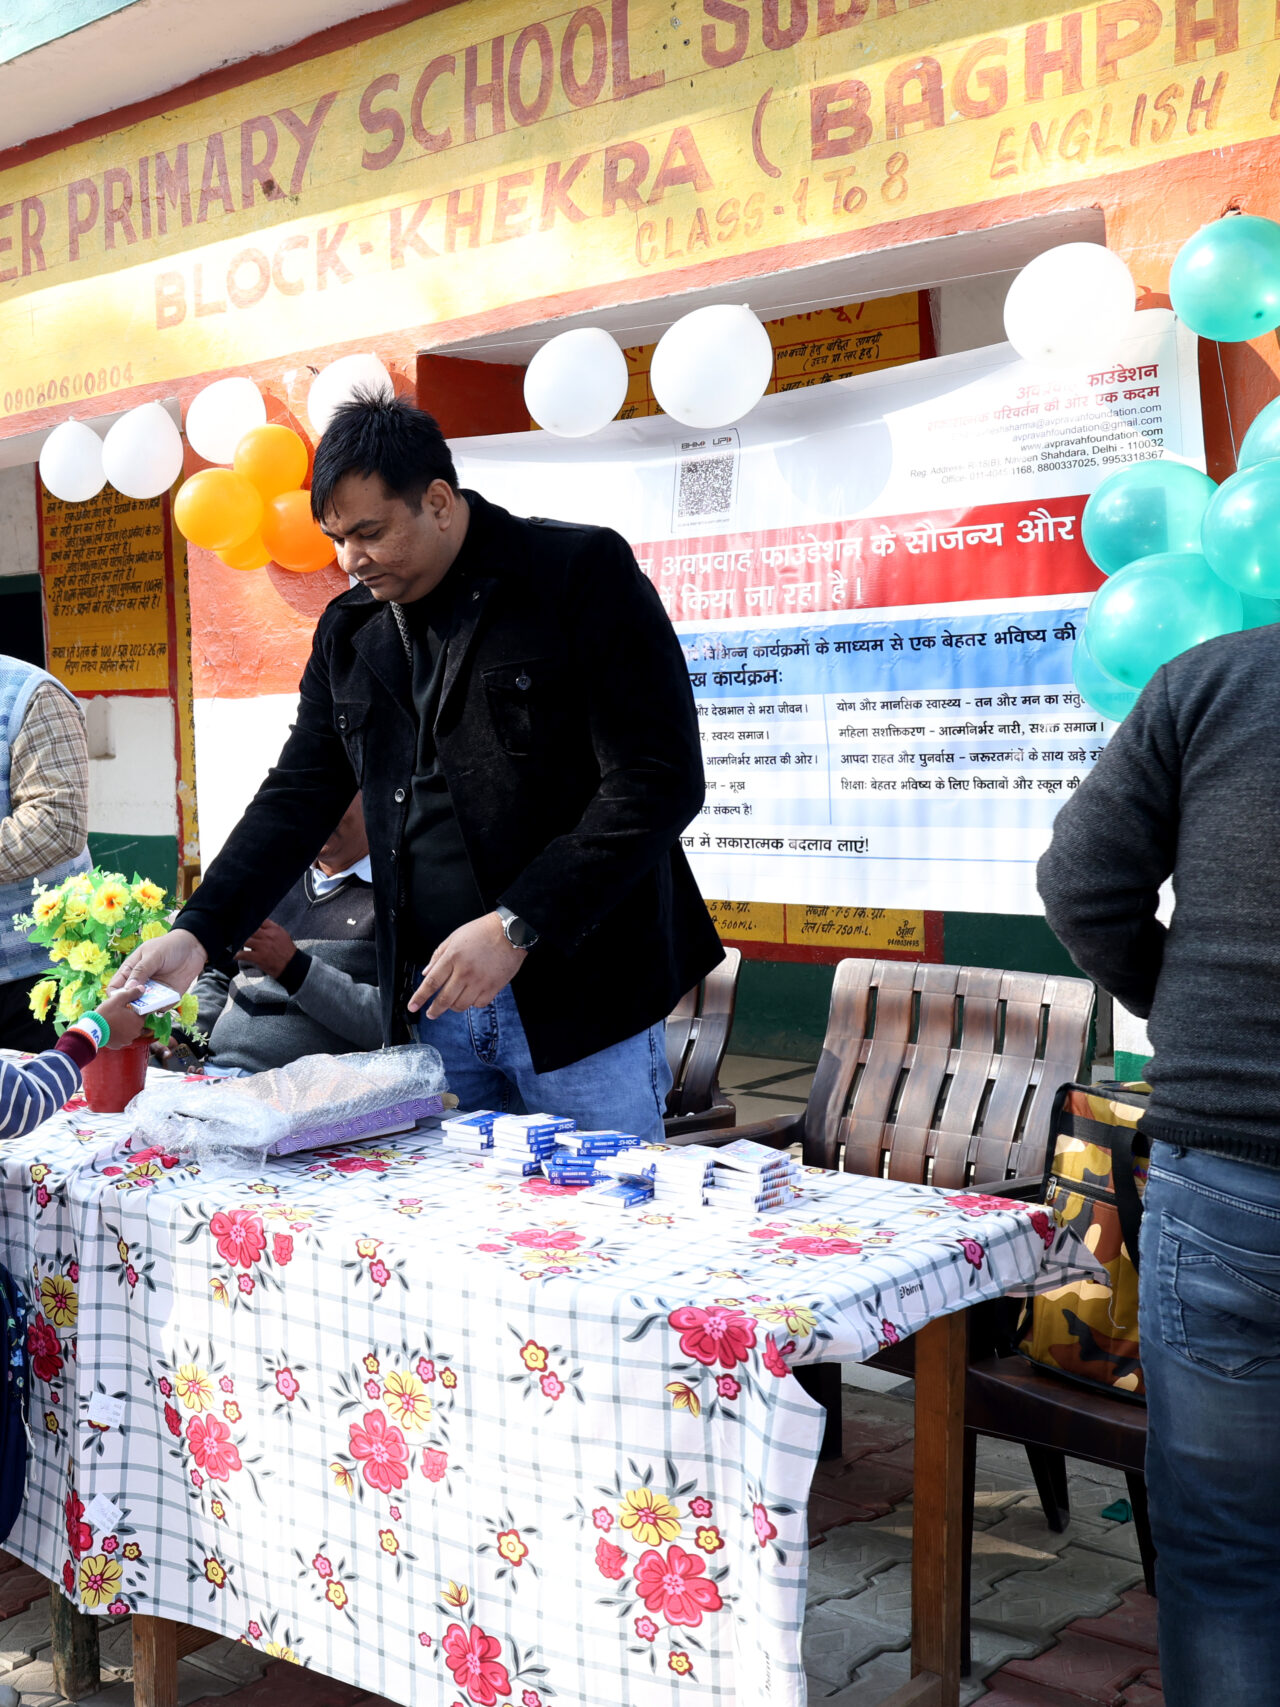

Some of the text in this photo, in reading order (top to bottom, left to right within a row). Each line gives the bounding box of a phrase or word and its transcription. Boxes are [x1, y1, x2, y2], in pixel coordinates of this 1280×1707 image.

[68, 91, 341, 263] PRIMARY
[359, 0, 666, 172] SCHOOL
[881, 151, 910, 204] 8
[990, 70, 1229, 180] ENGLISH
[1087, 363, 1159, 388] फाउंडेशन
[993, 401, 1039, 421] परिवर्तन
[1044, 399, 1060, 413] की
[1095, 391, 1118, 406] एक
[1123, 385, 1160, 401] कदम
[1092, 443, 1118, 455] Delhi
[661, 545, 754, 577] अवप्रवाह
[761, 534, 863, 566] फाउंडेशन
[870, 524, 896, 557] के
[904, 519, 1005, 554] सौजन्य
[1016, 507, 1076, 543] और
[680, 583, 737, 613] किया
[744, 585, 775, 606] जा
[782, 581, 822, 606] रहा
[753, 638, 810, 659] कार्यक्रमों
[815, 638, 831, 655] के
[834, 637, 883, 655] माध्यम
[889, 633, 903, 651] से
[909, 634, 936, 652] एक
[941, 629, 987, 648] बेहतर
[994, 625, 1047, 645] भविष्य
[1053, 621, 1077, 642] की
[711, 704, 745, 716] देखभाल
[747, 702, 756, 715] से
[759, 704, 775, 715] भरा
[836, 700, 856, 713] योग
[859, 698, 877, 711] और
[880, 697, 923, 711] मानसिक
[975, 697, 992, 708] तन
[996, 693, 1017, 708] और
[1022, 695, 1040, 706] मन
[1044, 694, 1059, 705] का
[838, 724, 868, 738] महिला
[872, 723, 925, 737] सशक्तिकरण
[938, 720, 994, 736] आत्मनिर्भर
[706, 752, 751, 766] आत्मनिर्भर
[754, 755, 777, 765] भारत
[780, 752, 792, 764] की
[840, 753, 869, 765] आपदा
[872, 752, 894, 765] राहत
[898, 750, 915, 764] और
[920, 749, 955, 767] पुनर्वास
[1028, 747, 1038, 762] के
[1042, 751, 1064, 762] साथ
[729, 781, 746, 793] भूख
[871, 775, 897, 791] बेहतर
[900, 776, 932, 791] भविष्य
[935, 776, 945, 791] के
[948, 776, 970, 791] लिए
[973, 775, 1009, 790] किताबों
[1012, 775, 1034, 790] और
[1037, 779, 1062, 794] स्कूल
[1067, 776, 1080, 790] की
[713, 803, 741, 815] संकल्प
[699, 832, 711, 849] में
[715, 837, 784, 850] सकारात्मक
[788, 838, 832, 851] बदलाव
